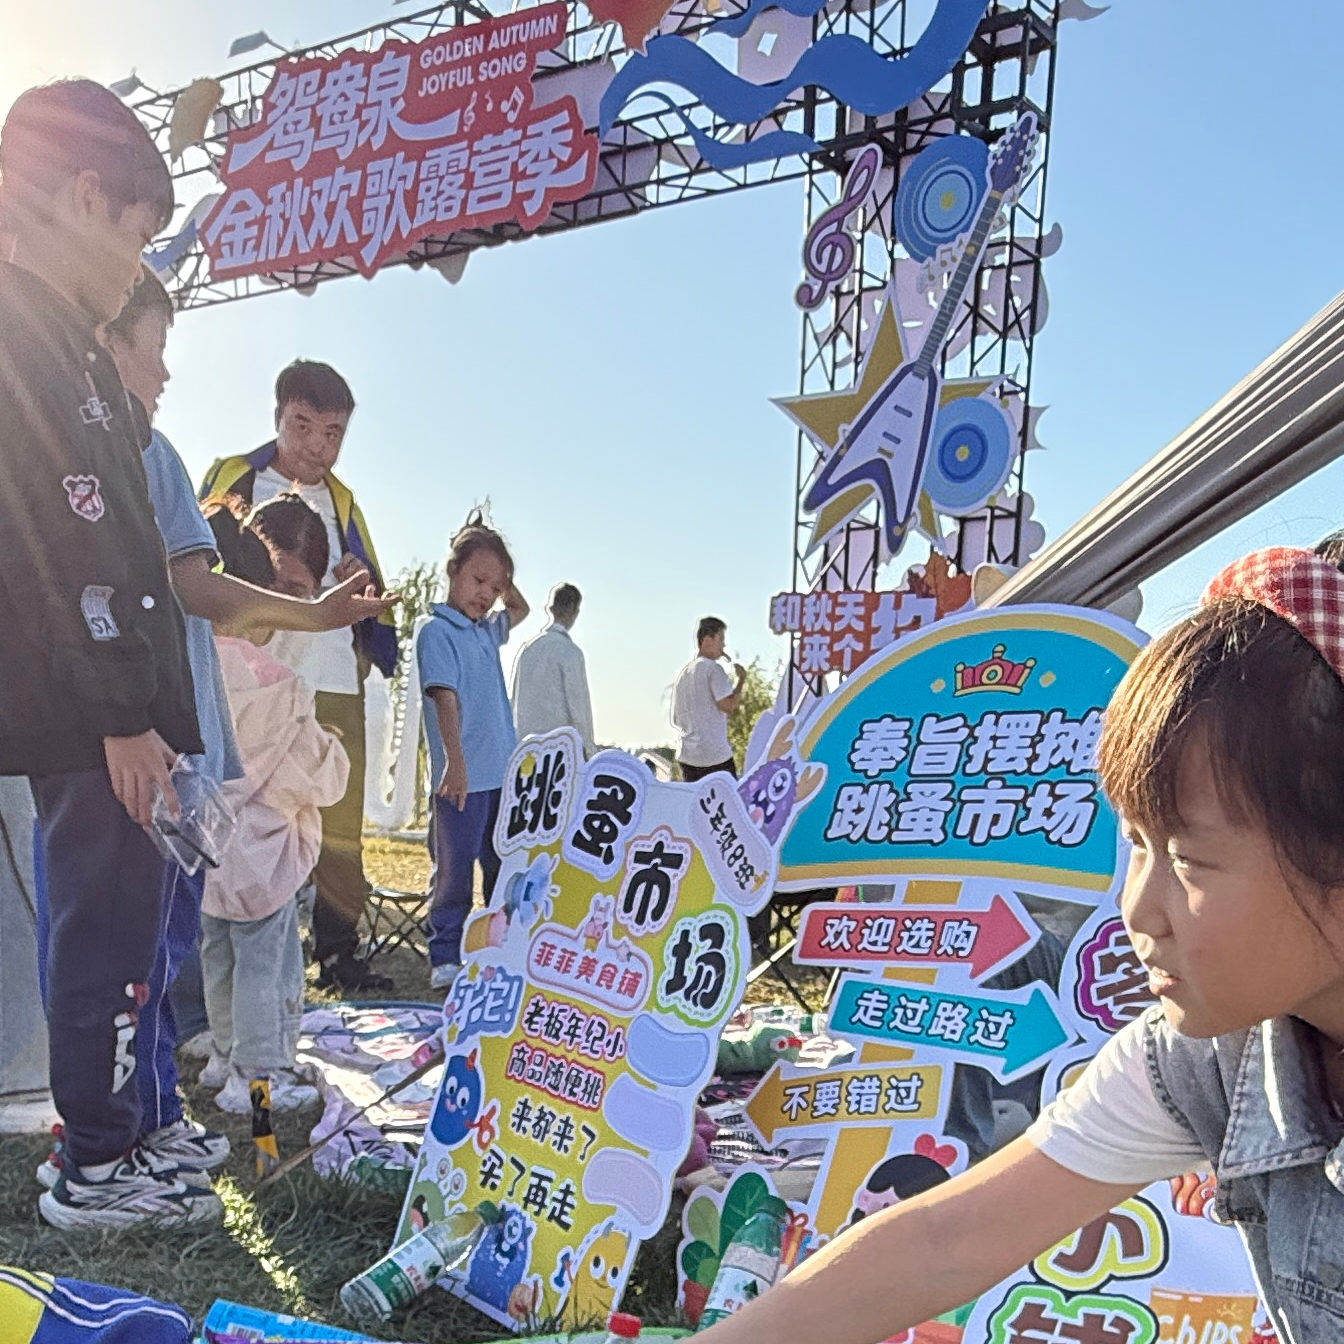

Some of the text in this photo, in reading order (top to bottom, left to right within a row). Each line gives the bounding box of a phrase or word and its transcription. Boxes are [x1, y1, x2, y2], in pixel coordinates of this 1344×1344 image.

[419, 14, 558, 70] GOLDEN AUTUMN
[417, 52, 527, 99] JOYFUL SONG
[228, 51, 460, 174] 鸳鸯泉
[205, 110, 588, 272] 金秋欢歌露营季
[771, 592, 867, 632] 和秋天
[800, 633, 864, 673] 来个
[850, 711, 1106, 777] 奉旨摆摊
[825, 780, 1098, 846] 跳蚤市场
[819, 916, 979, 957] 欢迎选购
[533, 941, 644, 999] 菲菲美食铺
[523, 998, 624, 1058] 老板年纪小
[850, 989, 1014, 1050] 走过路过
[508, 1046, 602, 1106] 商品随便挑
[781, 1075, 924, 1121] 不要错过
[511, 1098, 597, 1162] 来都来了
[478, 1148, 577, 1232] 买了再走
